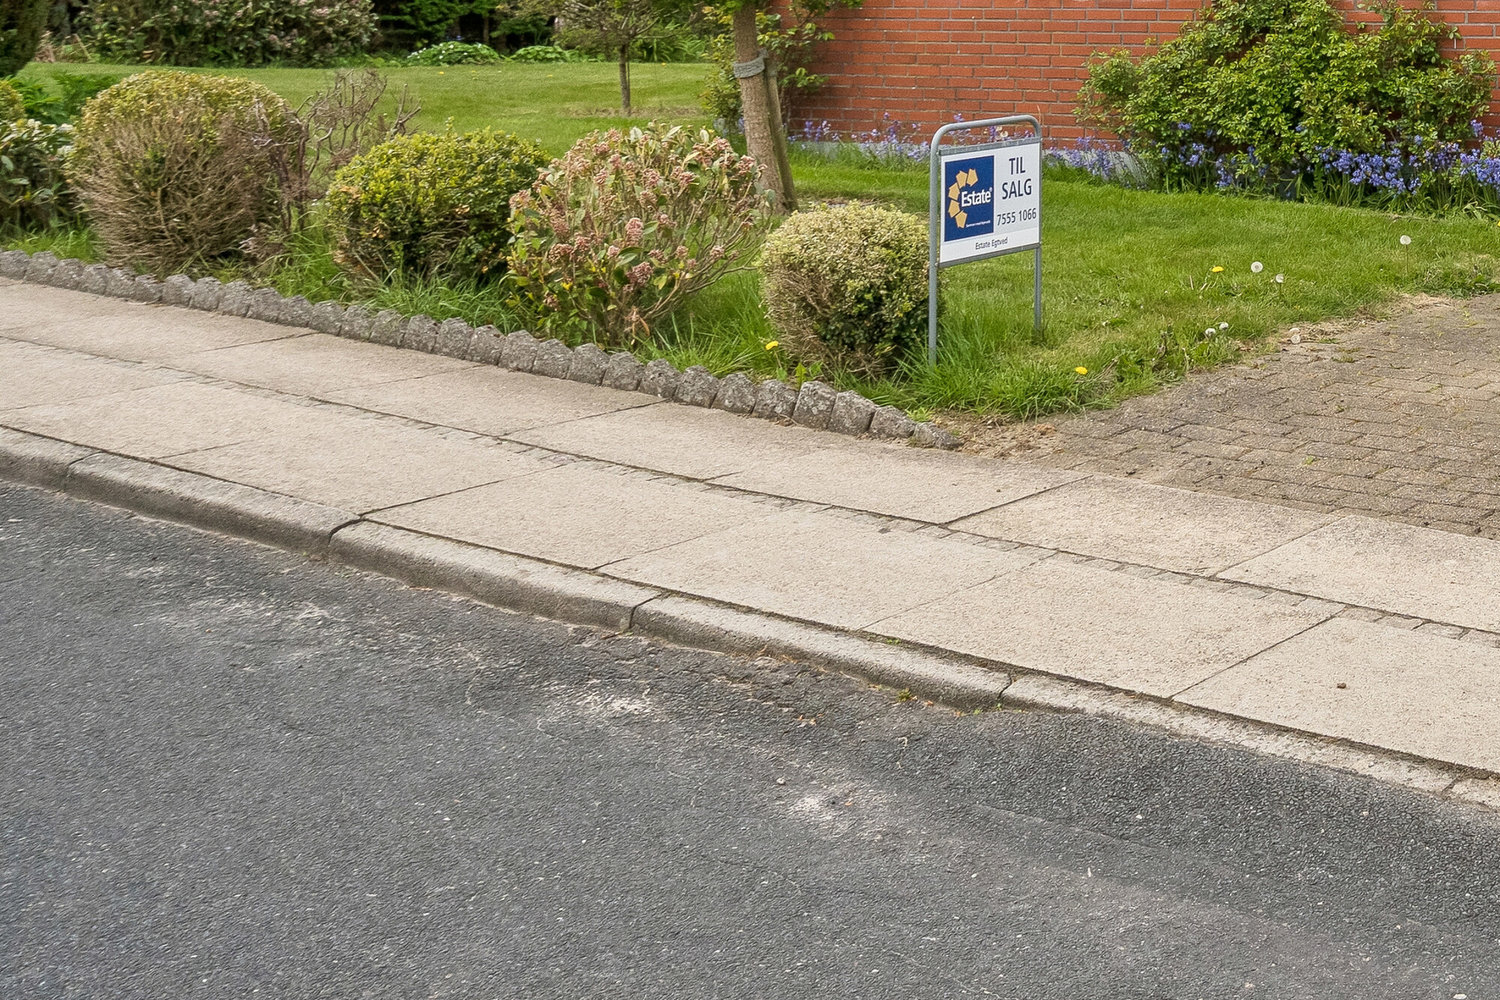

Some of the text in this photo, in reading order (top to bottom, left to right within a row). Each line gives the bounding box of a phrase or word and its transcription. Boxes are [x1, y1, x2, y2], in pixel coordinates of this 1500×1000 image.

[1009, 156, 1026, 175] TIL
[961, 189, 991, 207] Estate
[1002, 178, 1032, 200] SALG
[997, 212, 1016, 226] 7555
[1019, 208, 1037, 221] 1066
[975, 242, 991, 250] Estate
